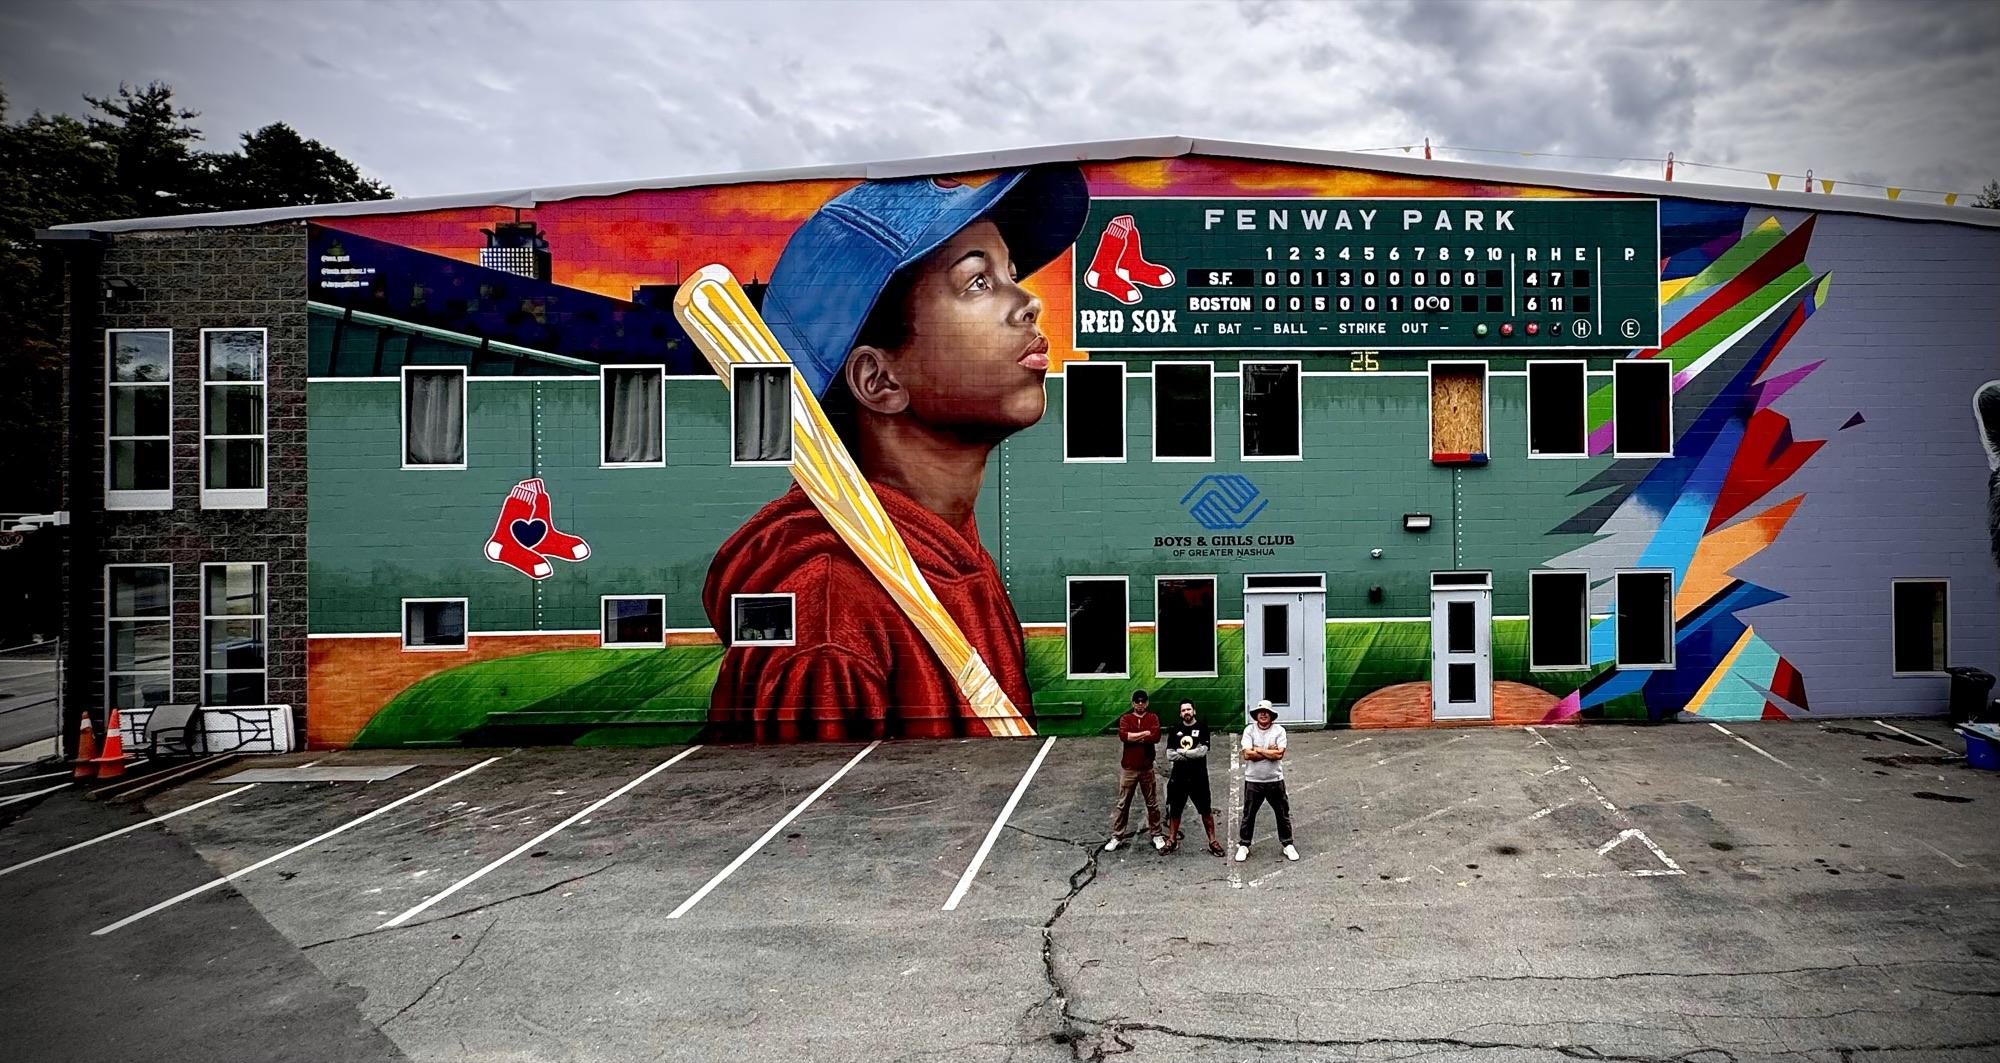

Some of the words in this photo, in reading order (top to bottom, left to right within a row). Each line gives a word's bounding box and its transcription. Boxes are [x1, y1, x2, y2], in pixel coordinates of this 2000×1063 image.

[1205, 209, 1377, 230] FENWAY
[1403, 209, 1515, 231] PARK
[1266, 247, 1273, 261] 1
[1289, 247, 1300, 261] 2
[1314, 247, 1325, 261] 3
[1338, 247, 1350, 261] 4
[1364, 247, 1375, 261] 5
[1389, 247, 1400, 261] 6
[1414, 247, 1425, 261] 7
[1439, 247, 1450, 261] 8
[1464, 247, 1475, 261] 9
[1486, 247, 1503, 261] 10
[1526, 247, 1537, 261] R
[1551, 247, 1561, 261] H
[1575, 247, 1586, 261] E
[1208, 271, 1233, 286] S.F.
[1265, 272, 1276, 286] 0
[1289, 272, 1300, 286] 0
[1316, 272, 1323, 286] 1
[1339, 272, 1350, 286] 3
[1364, 272, 1375, 286] 0
[1389, 272, 1400, 286] 0
[1414, 272, 1425, 286] 0
[1440, 272, 1451, 286] 0
[1464, 272, 1475, 286] 0
[1526, 272, 1538, 286] 4
[1551, 272, 1562, 286] 7
[1189, 297, 1251, 311] BOSTON
[1265, 297, 1276, 311] 0
[1289, 297, 1300, 311] 0
[1314, 297, 1326, 311] 5
[1339, 297, 1350, 311] 0
[1364, 297, 1375, 311] 0
[1390, 297, 1398, 311] 1
[1414, 297, 1425, 311] 0
[1439, 297, 1450, 311] 0
[1527, 297, 1538, 311] 6
[1550, 297, 1563, 311] 11
[1080, 309, 1124, 334] RED
[1131, 309, 1178, 334] SOX
[1193, 323, 1210, 334] AT
[1218, 323, 1242, 334] BAT
[1273, 323, 1308, 334] BALL
[1338, 323, 1387, 334] STRIKE
[1401, 323, 1429, 334] OUT
[1350, 351, 1379, 371] 26
[1154, 536, 1192, 547] BOYS
[1196, 536, 1208, 547] &
[1211, 535, 1254, 547] GIRLS
[1257, 535, 1295, 546] CLUB
[1172, 549, 1186, 558] OF
[1188, 548, 1234, 558] GREATER
[1236, 548, 1276, 557] NASHUA
